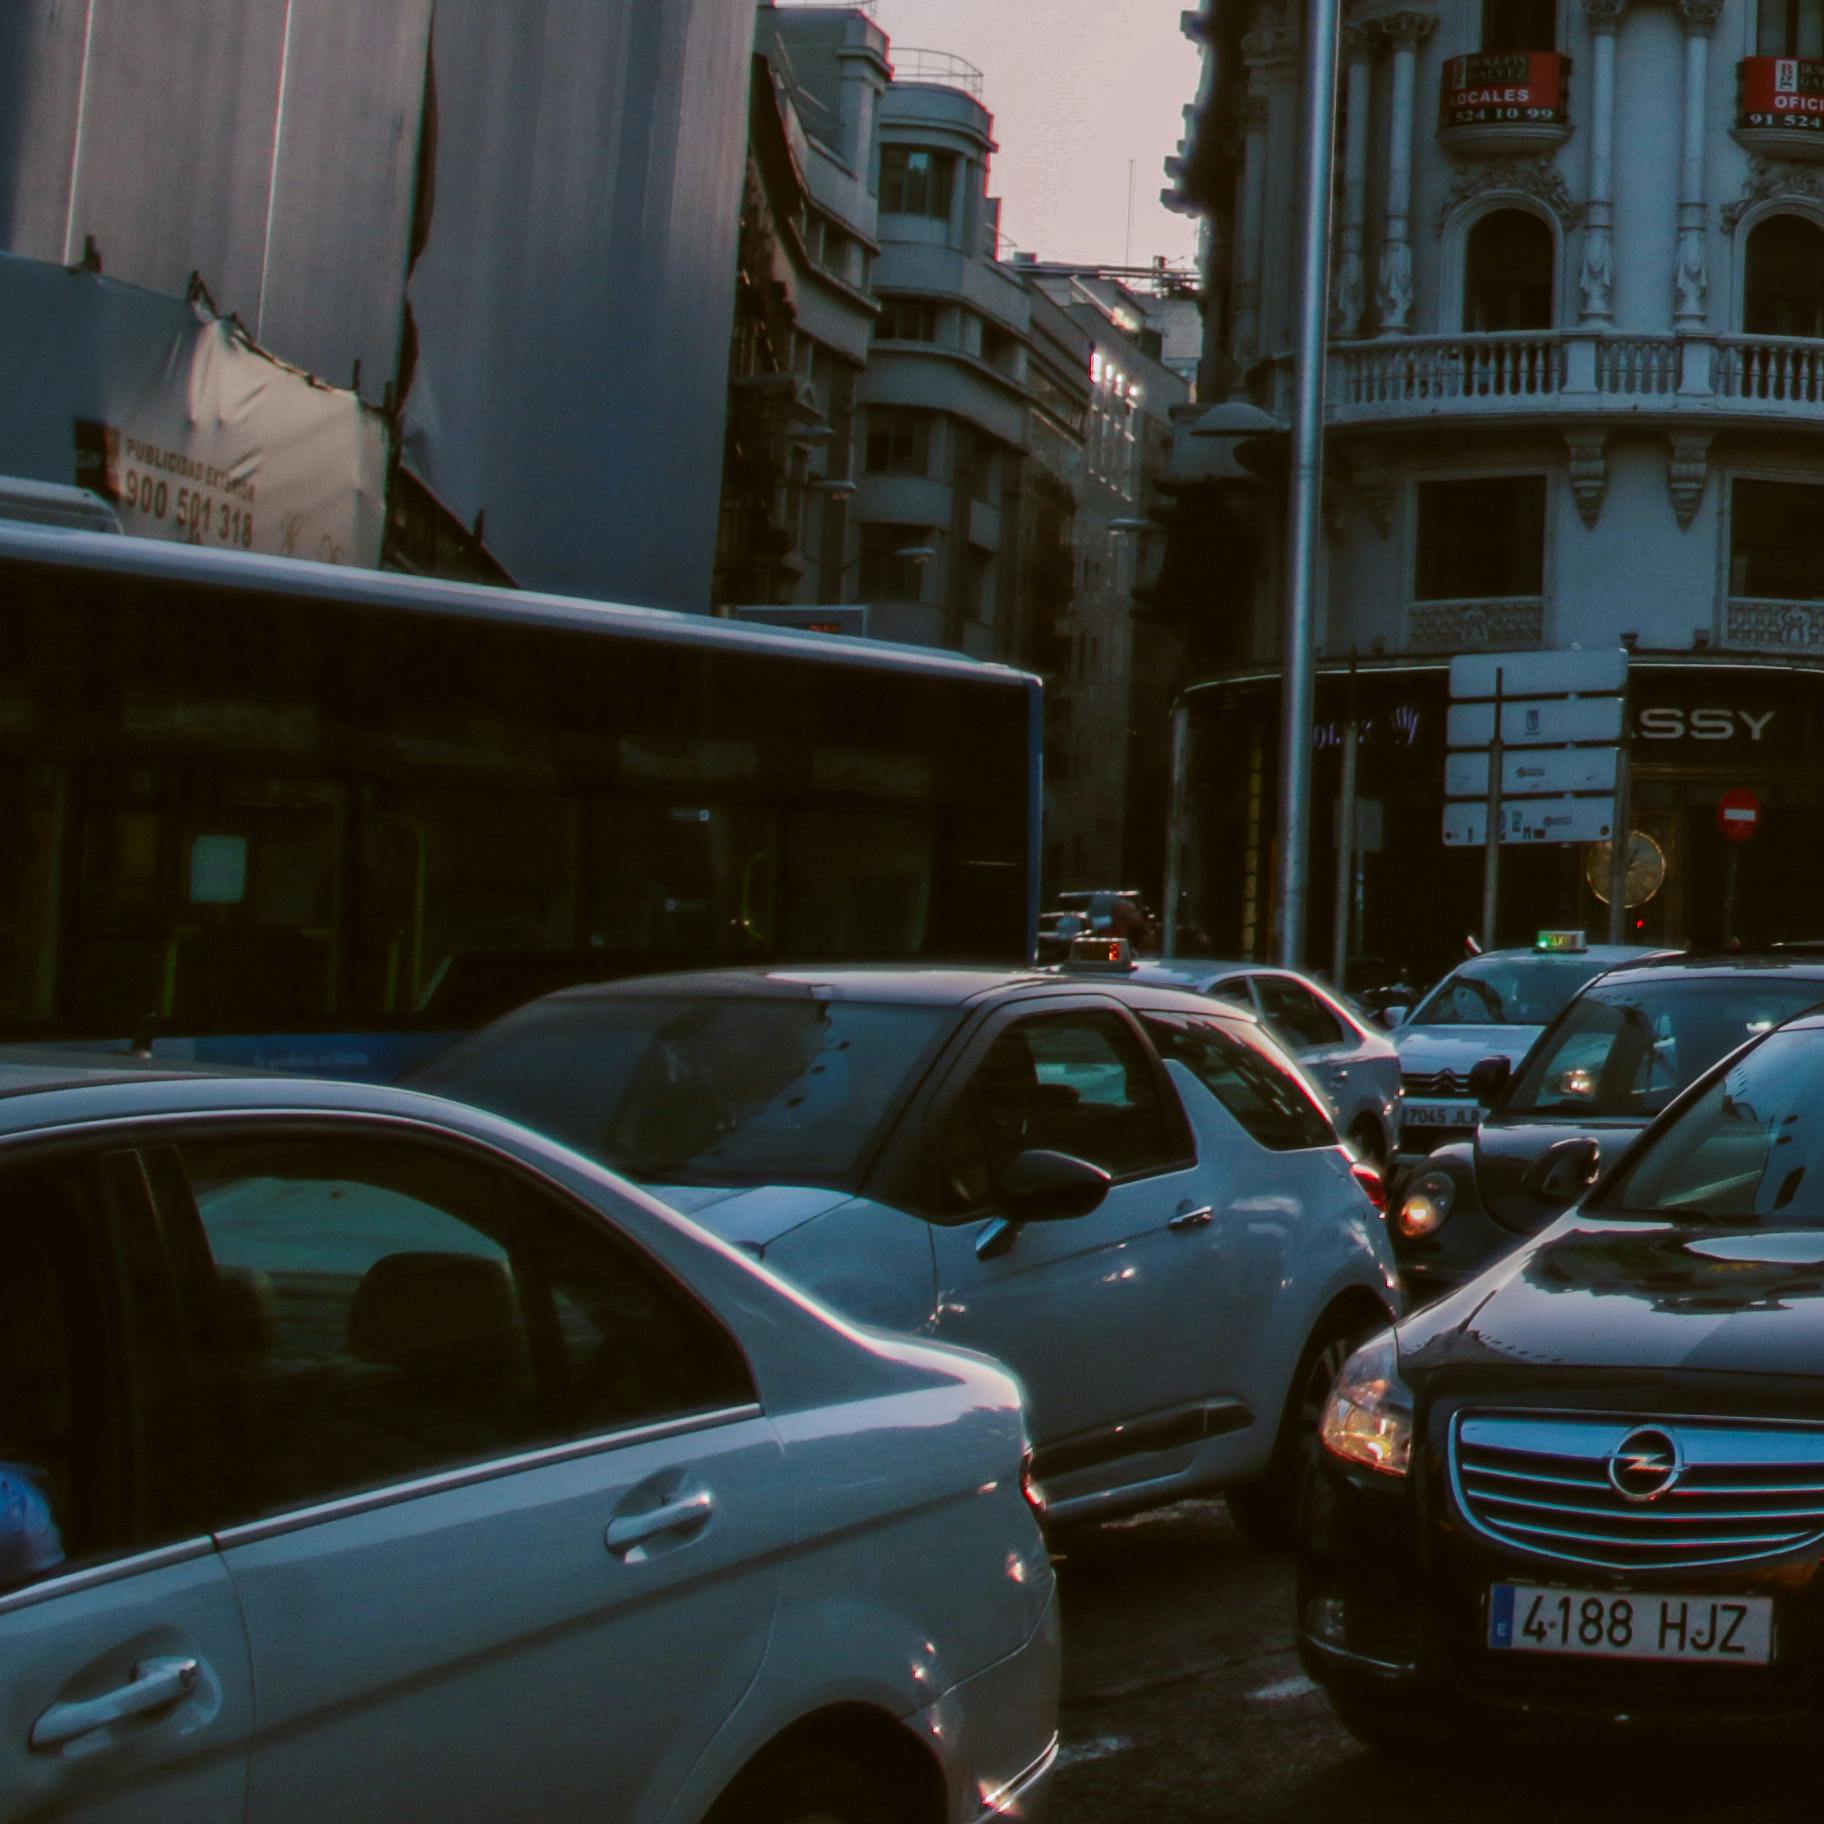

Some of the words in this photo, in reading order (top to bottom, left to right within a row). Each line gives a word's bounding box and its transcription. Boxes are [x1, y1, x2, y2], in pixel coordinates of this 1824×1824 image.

[1495, 107, 1519, 120] 10
[1527, 107, 1553, 120] 99
[1749, 113, 1773, 126] 91
[1784, 114, 1822, 129] 524
[127, 438, 203, 482] PUBLICIDAD
[126, 469, 168, 520] 900
[176, 487, 211, 534] 501
[220, 503, 253, 548] 318
[1521, 1594, 1634, 1648] 4188
[1657, 1600, 1748, 1654] HJZ
